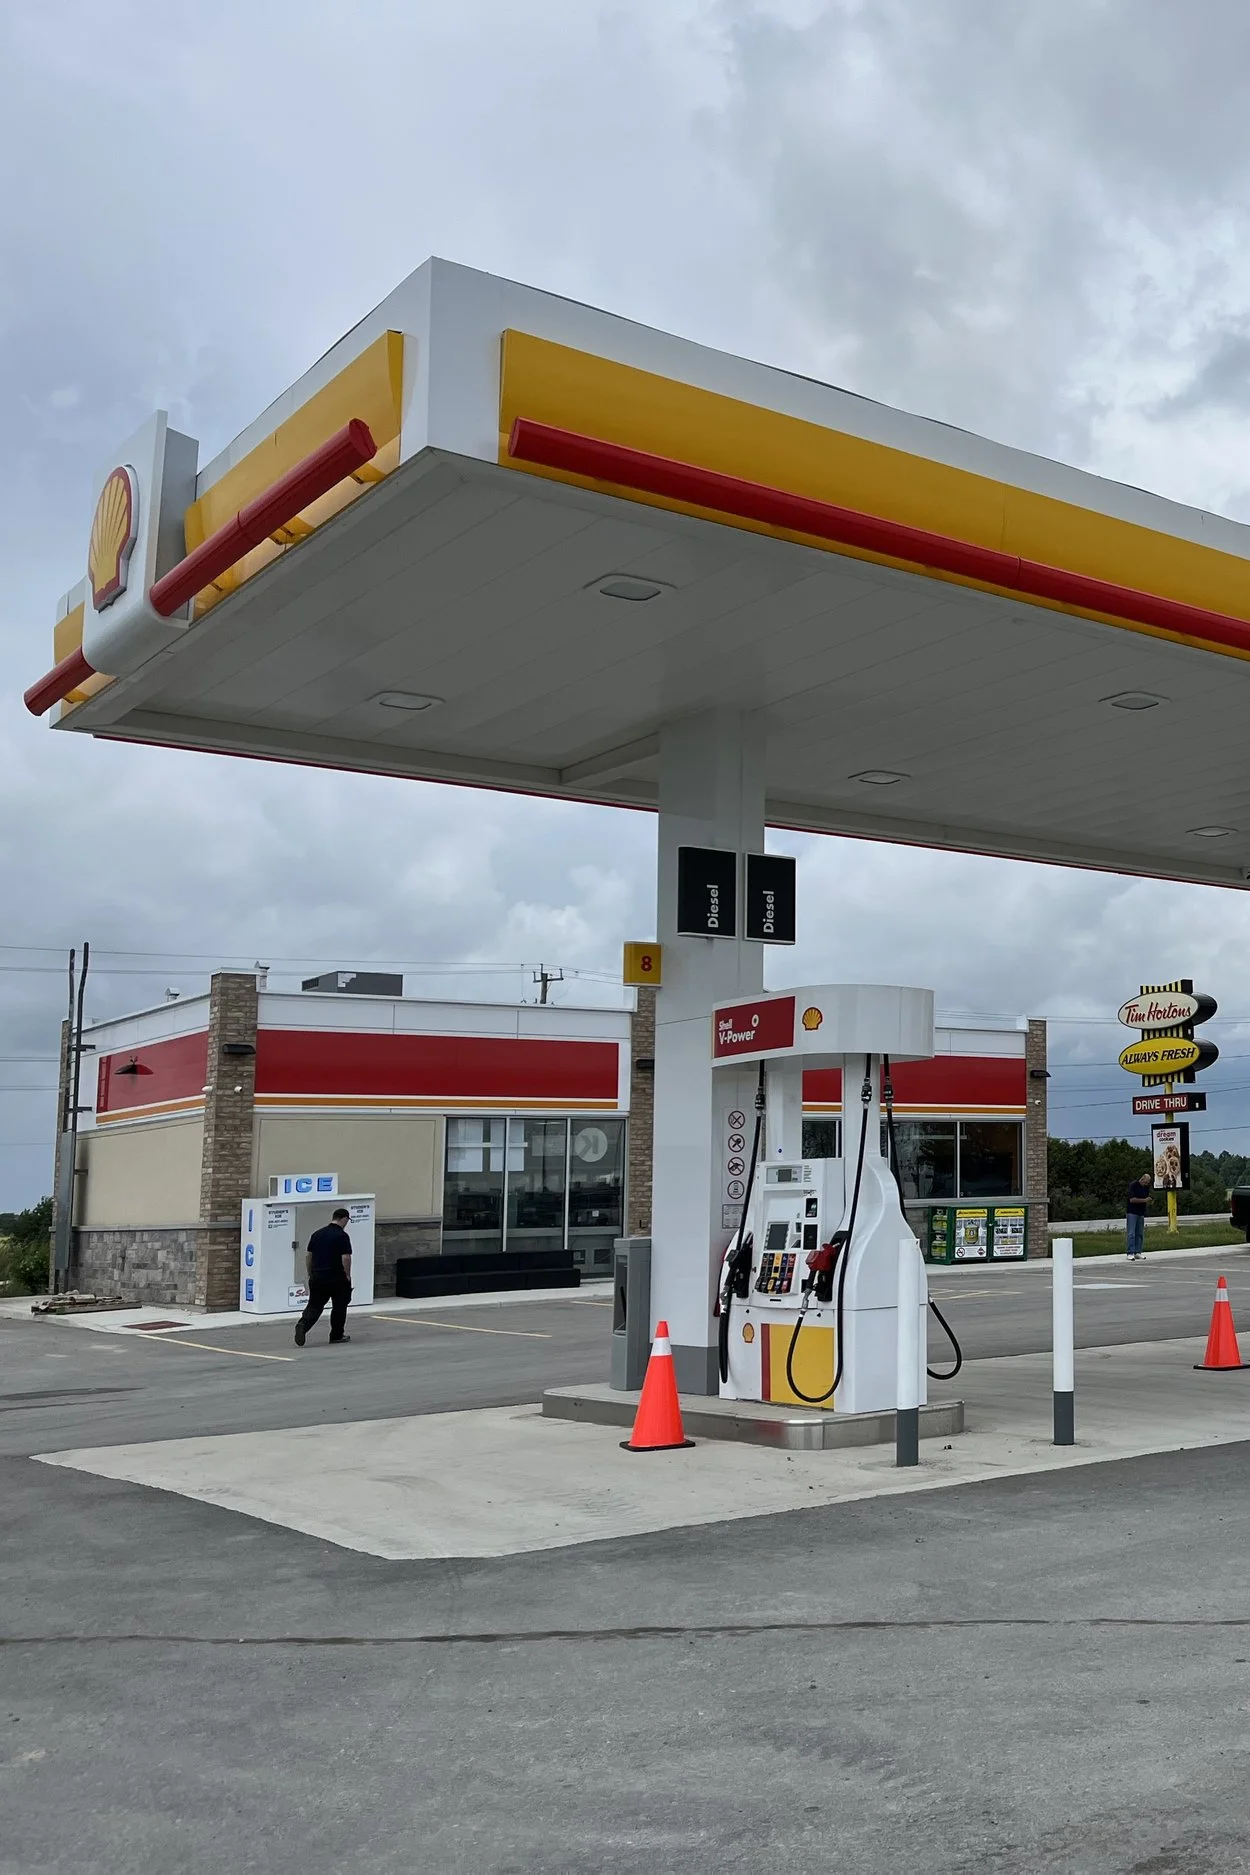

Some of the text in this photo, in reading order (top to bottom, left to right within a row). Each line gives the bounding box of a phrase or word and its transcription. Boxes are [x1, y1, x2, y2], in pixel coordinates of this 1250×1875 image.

[706, 884, 719, 928] Diesel
[762, 890, 775, 933] Diesel
[640, 955, 653, 972] 8
[1125, 1001, 1191, 1024] Tim Hortons
[718, 1018, 733, 1031] Shell
[718, 1030, 756, 1045] V-Power
[1121, 1047, 1196, 1065] ALWAYS FRESH
[1135, 1096, 1187, 1111] DRIVE THRU
[284, 1176, 333, 1194] ICE
[245, 1208, 255, 1302] ICE
